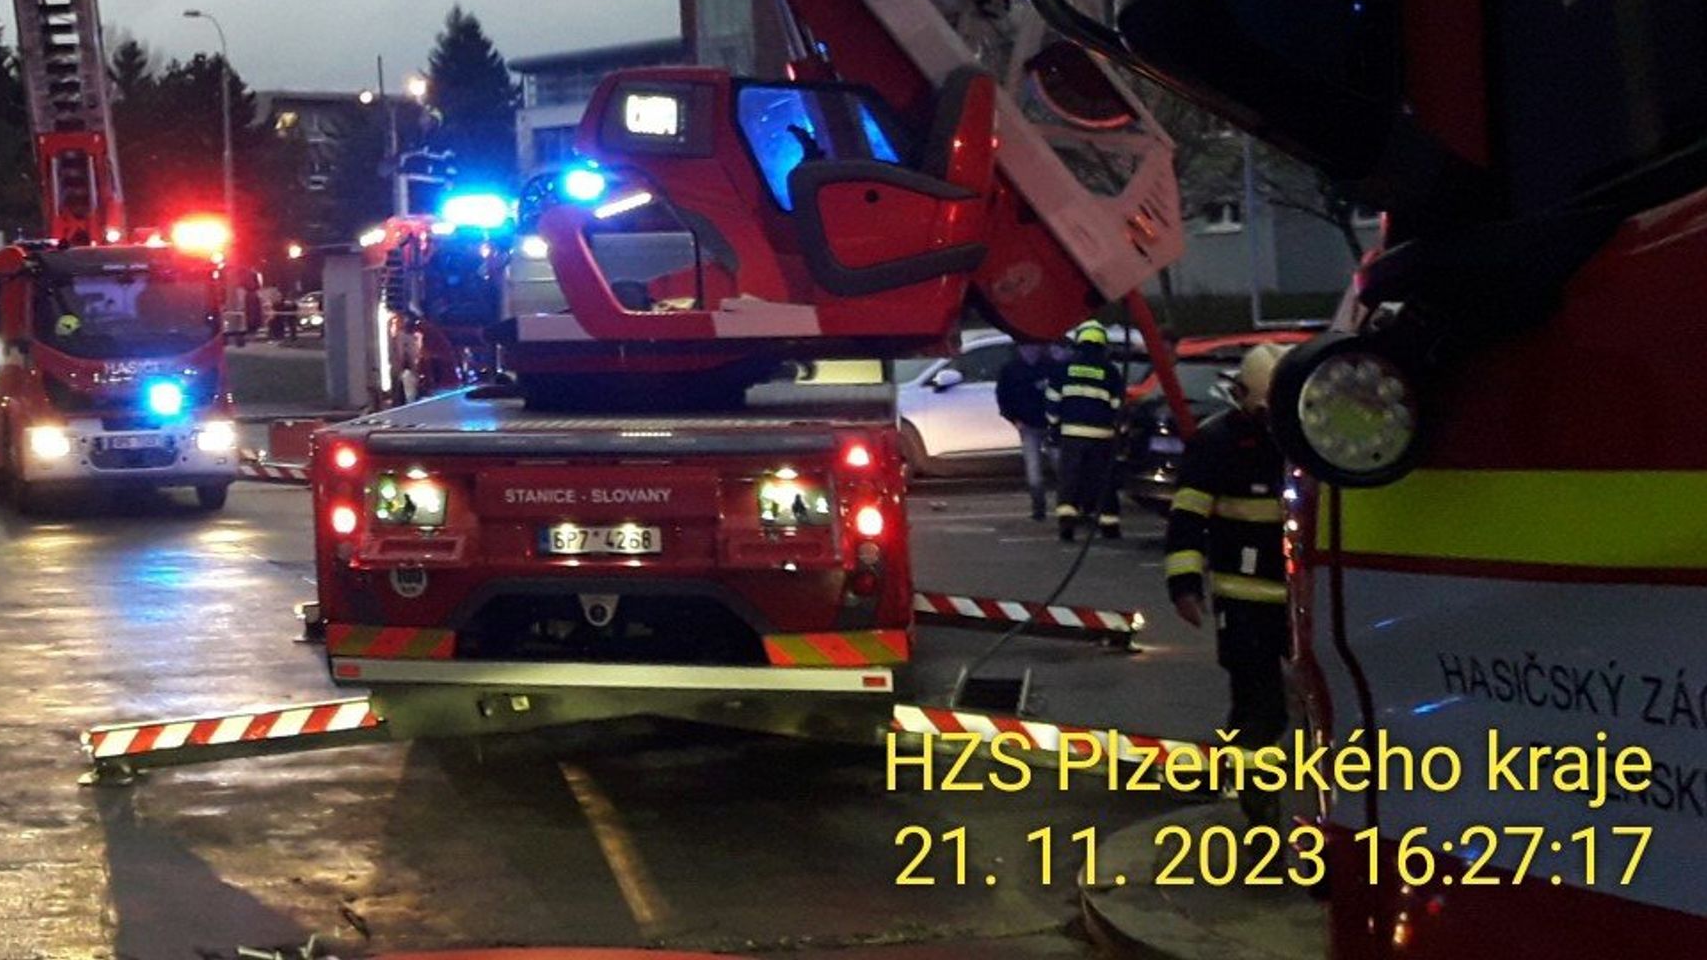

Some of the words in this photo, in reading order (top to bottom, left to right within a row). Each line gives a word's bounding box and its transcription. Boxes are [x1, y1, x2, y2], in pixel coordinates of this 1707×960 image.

[505, 488, 576, 503] STANICE
[591, 488, 672, 503] SLOVANY
[553, 529, 589, 550] 6P7
[1437, 650, 1626, 718] HASIČSKÝ
